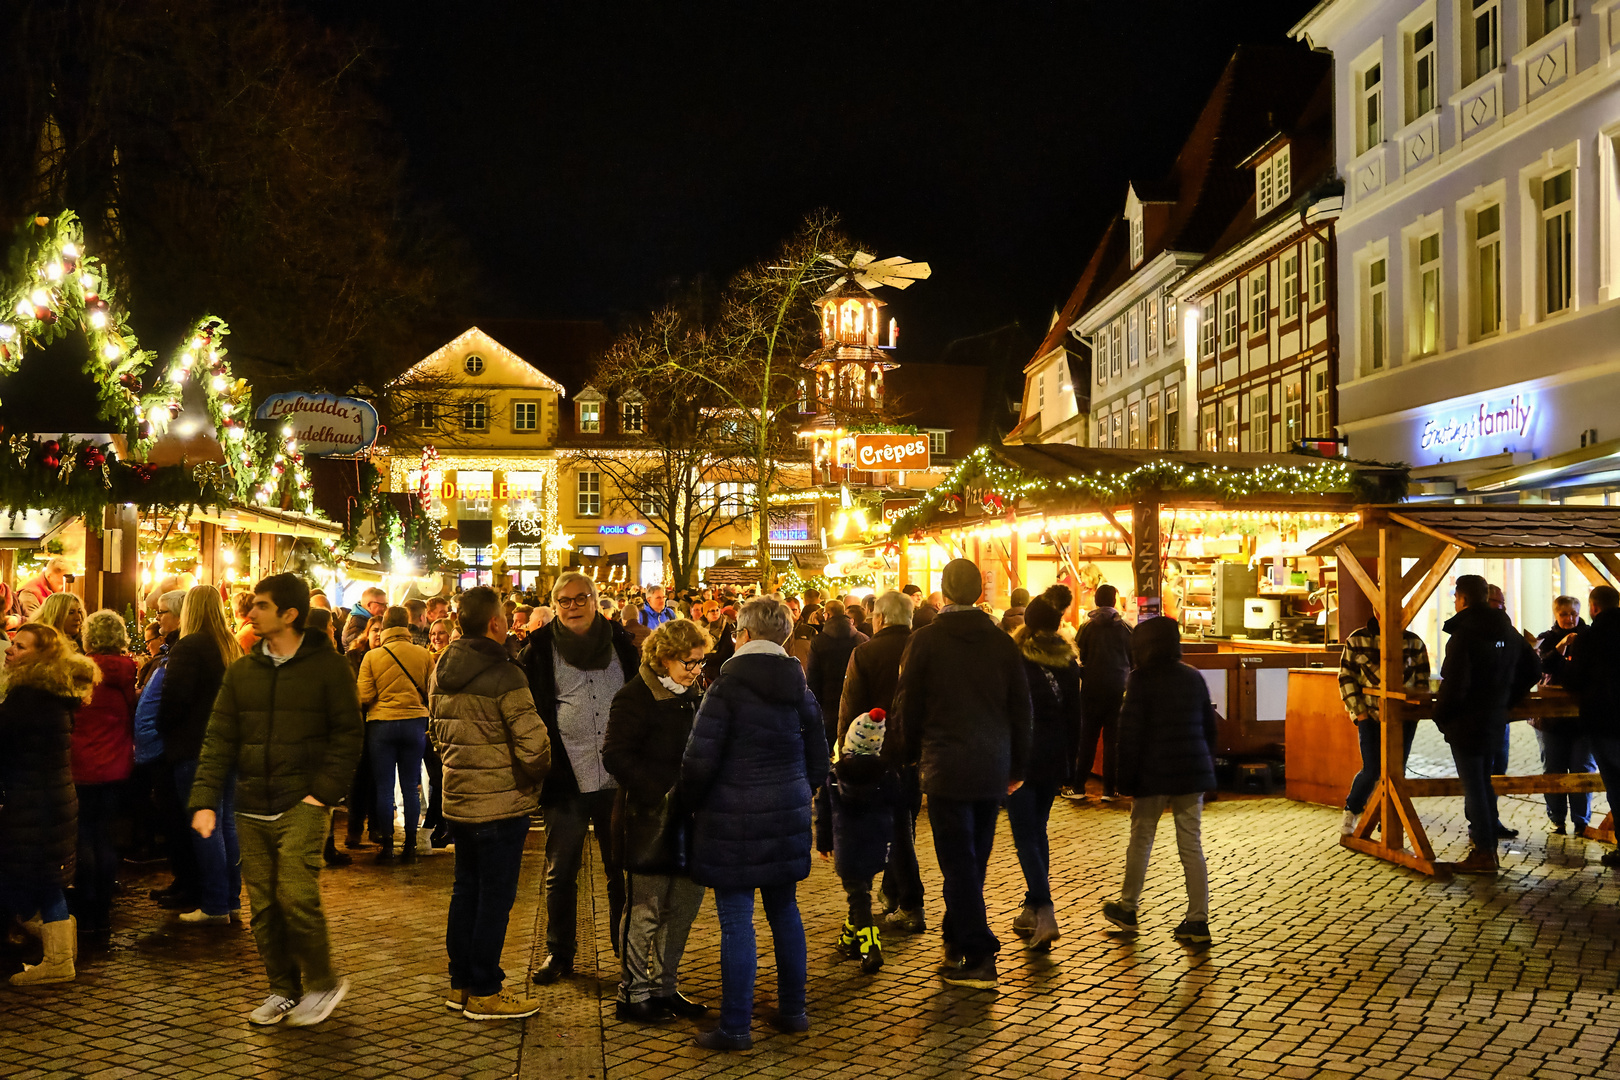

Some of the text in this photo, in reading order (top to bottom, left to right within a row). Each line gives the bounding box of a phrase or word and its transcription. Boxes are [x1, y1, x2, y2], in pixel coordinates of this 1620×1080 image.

[1479, 394, 1531, 437] family
[860, 440, 926, 465] Crêpes
[599, 525, 625, 535] Apollo
[1138, 508, 1156, 592] PIZZA
